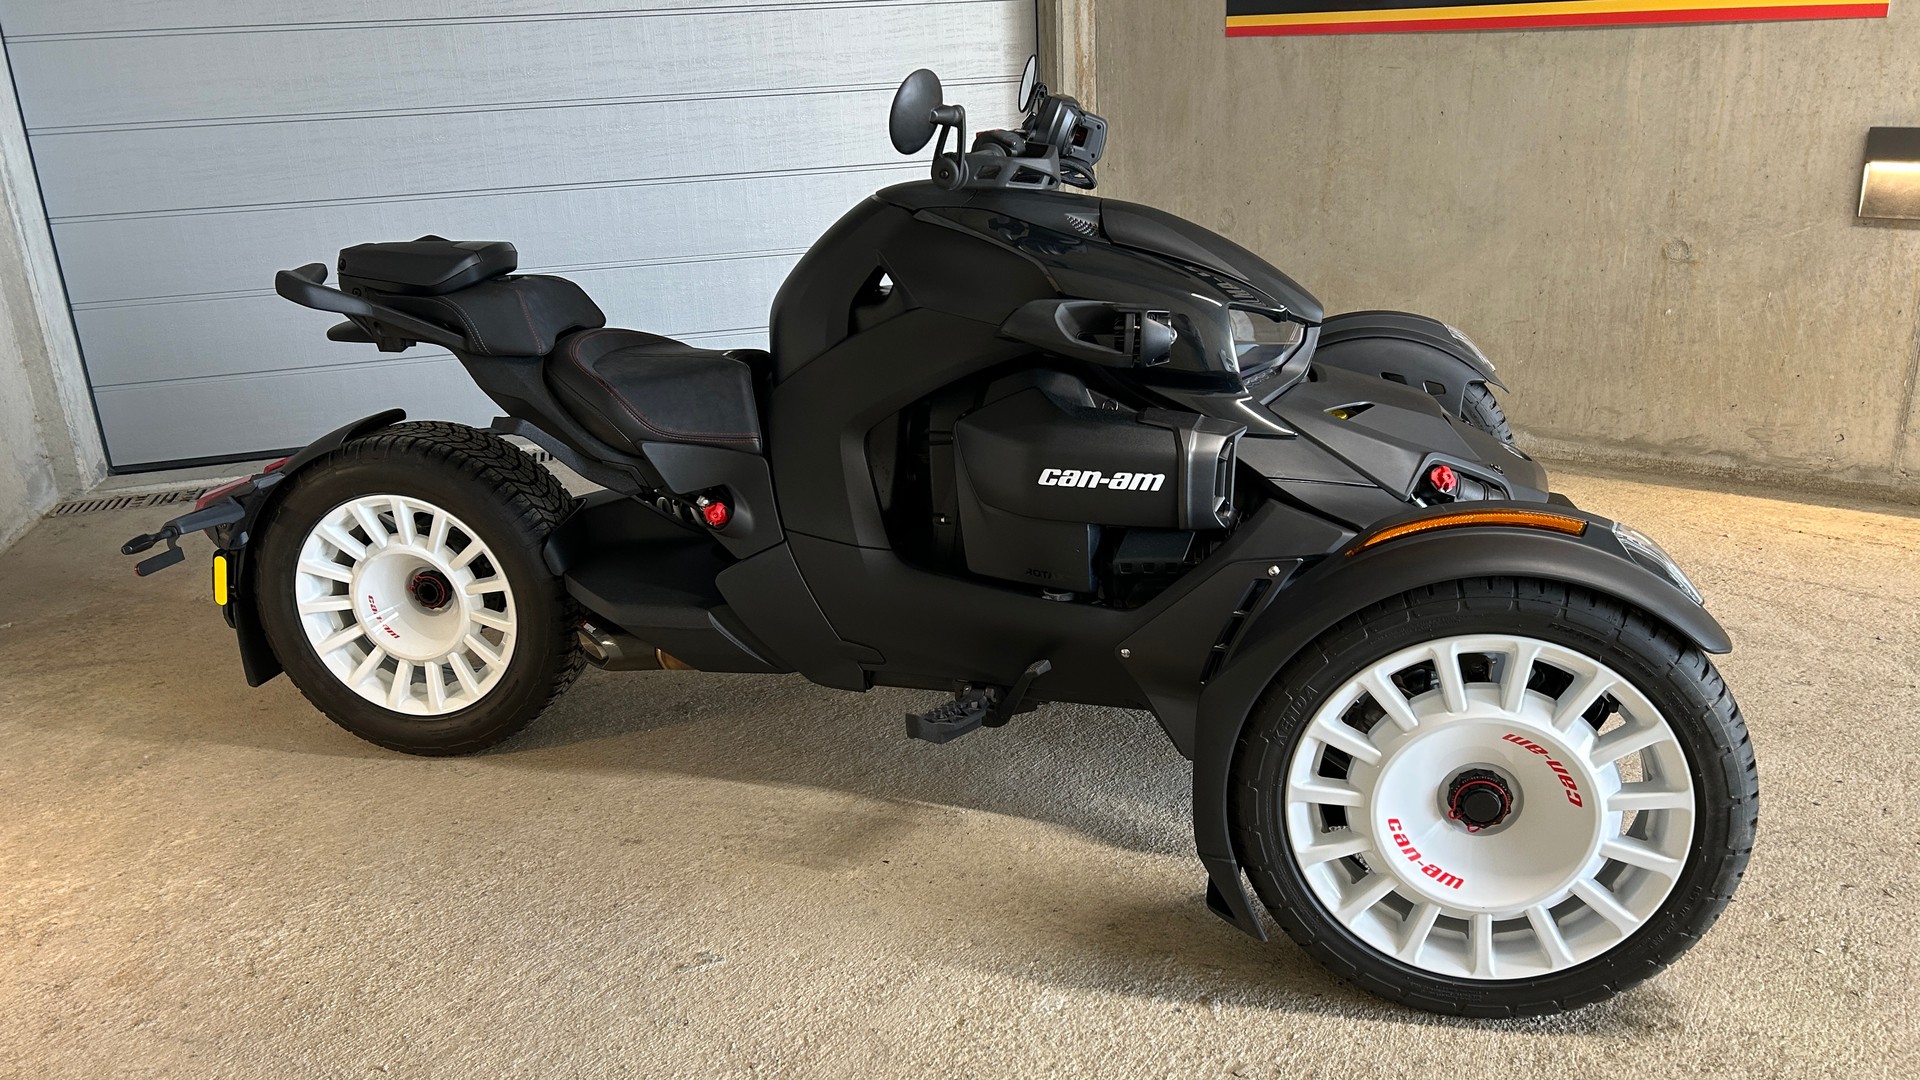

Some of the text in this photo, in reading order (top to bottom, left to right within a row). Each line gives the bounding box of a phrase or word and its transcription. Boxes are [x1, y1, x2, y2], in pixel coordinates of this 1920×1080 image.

[1038, 468, 1165, 491] can-am
[1273, 684, 1319, 746] KENDA
[1502, 733, 1583, 808] can-am
[1388, 818, 1464, 890] can-am
